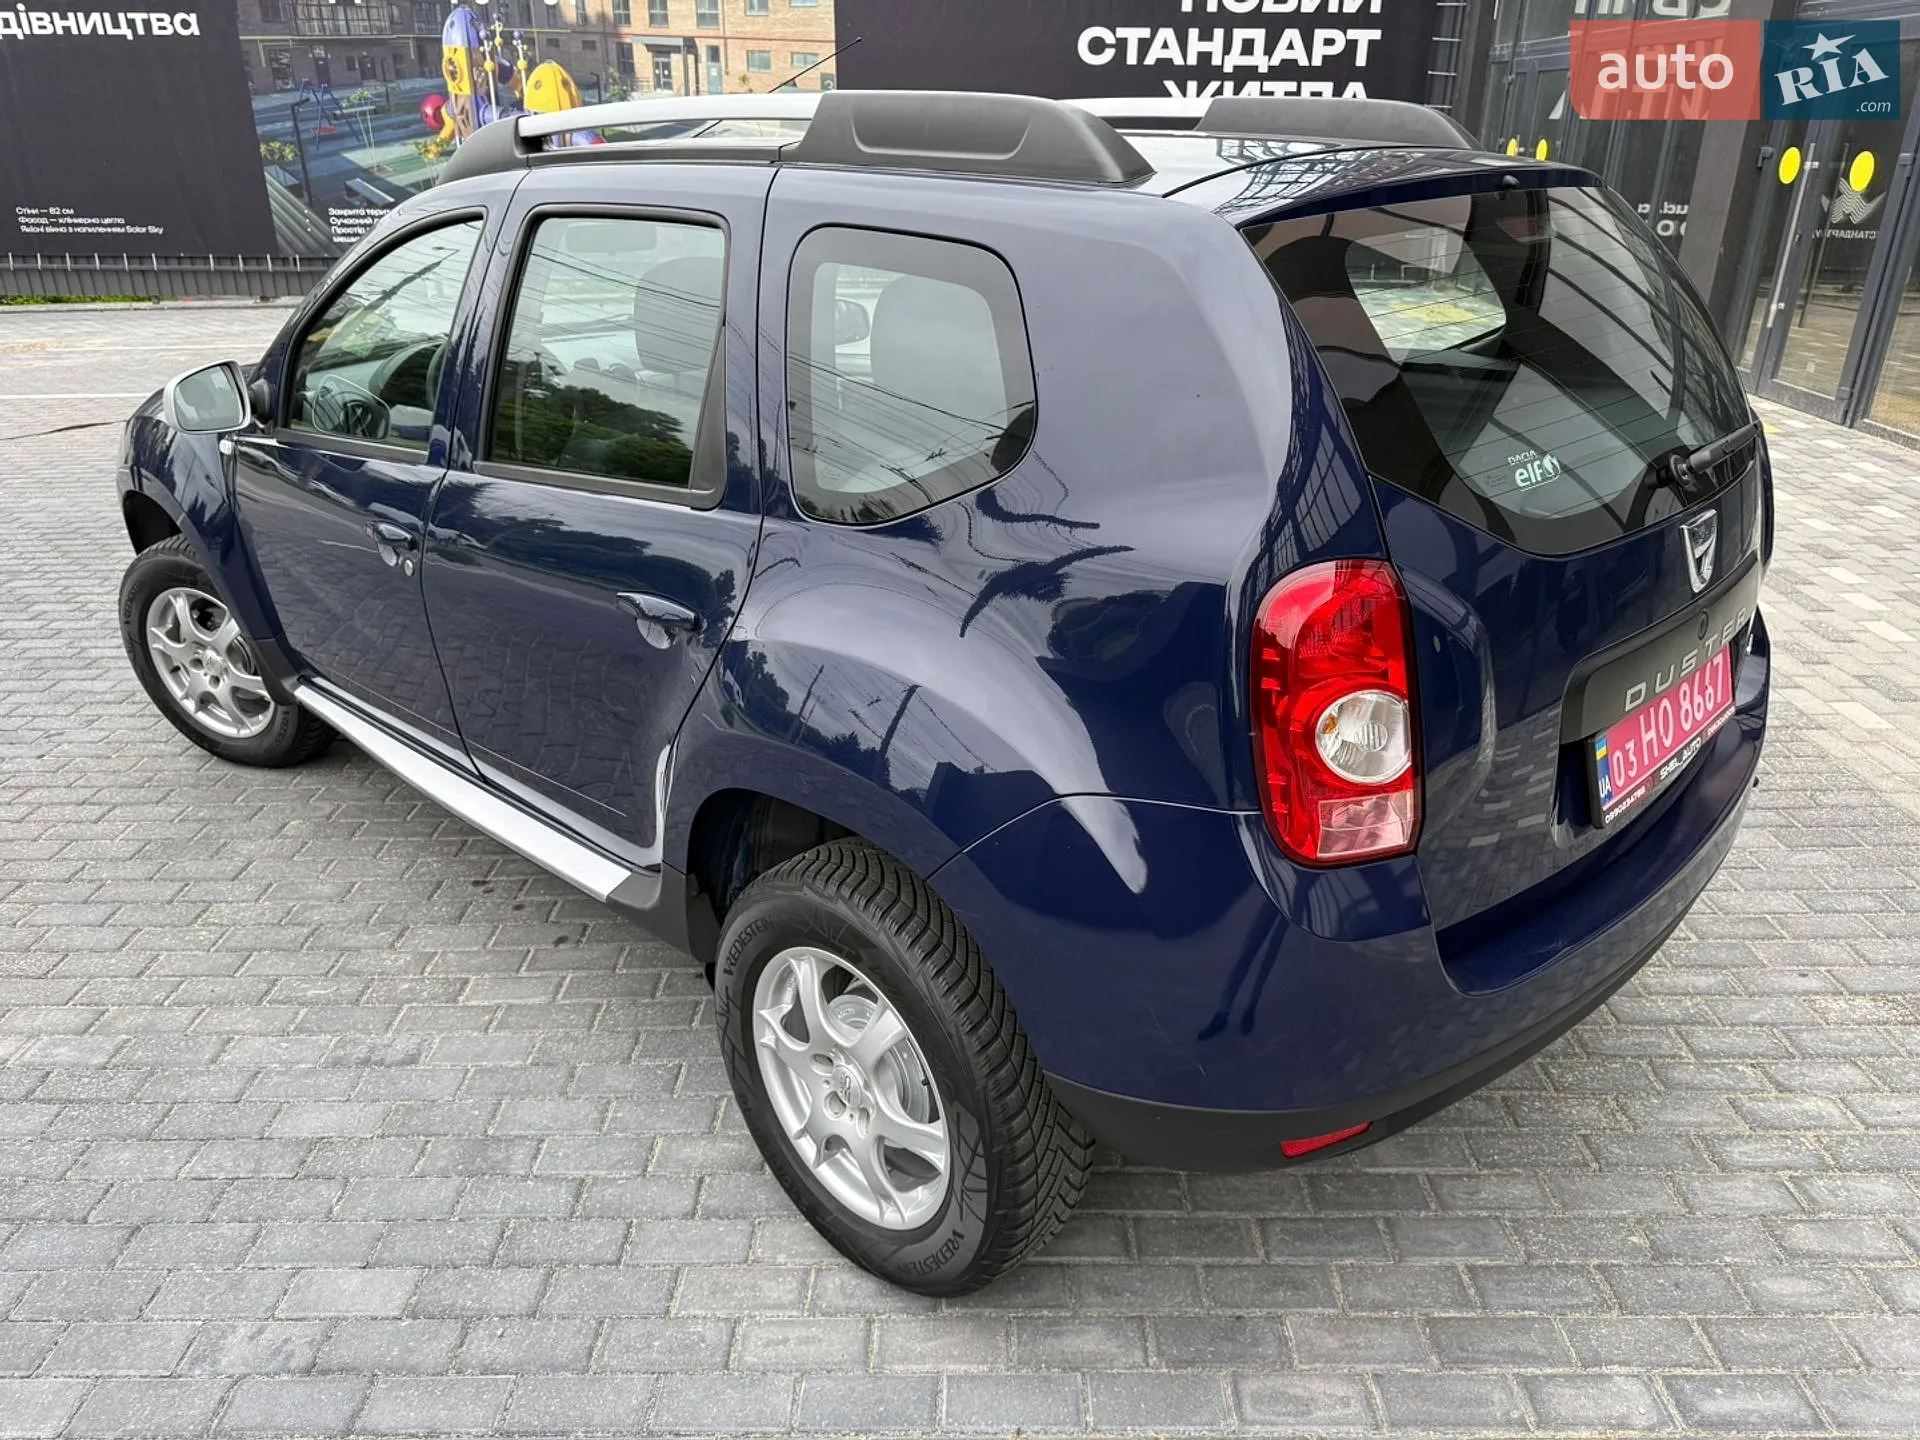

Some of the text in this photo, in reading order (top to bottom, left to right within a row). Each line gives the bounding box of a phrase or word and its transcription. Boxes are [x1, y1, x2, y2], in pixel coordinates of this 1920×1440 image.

[1077, 26, 1382, 73] СТАНДАРТ
[1625, 607, 1747, 712] DUSTER
[1612, 738, 1638, 788] 03
[1679, 652, 1724, 732] 8667
[1599, 774, 1611, 798] UA
